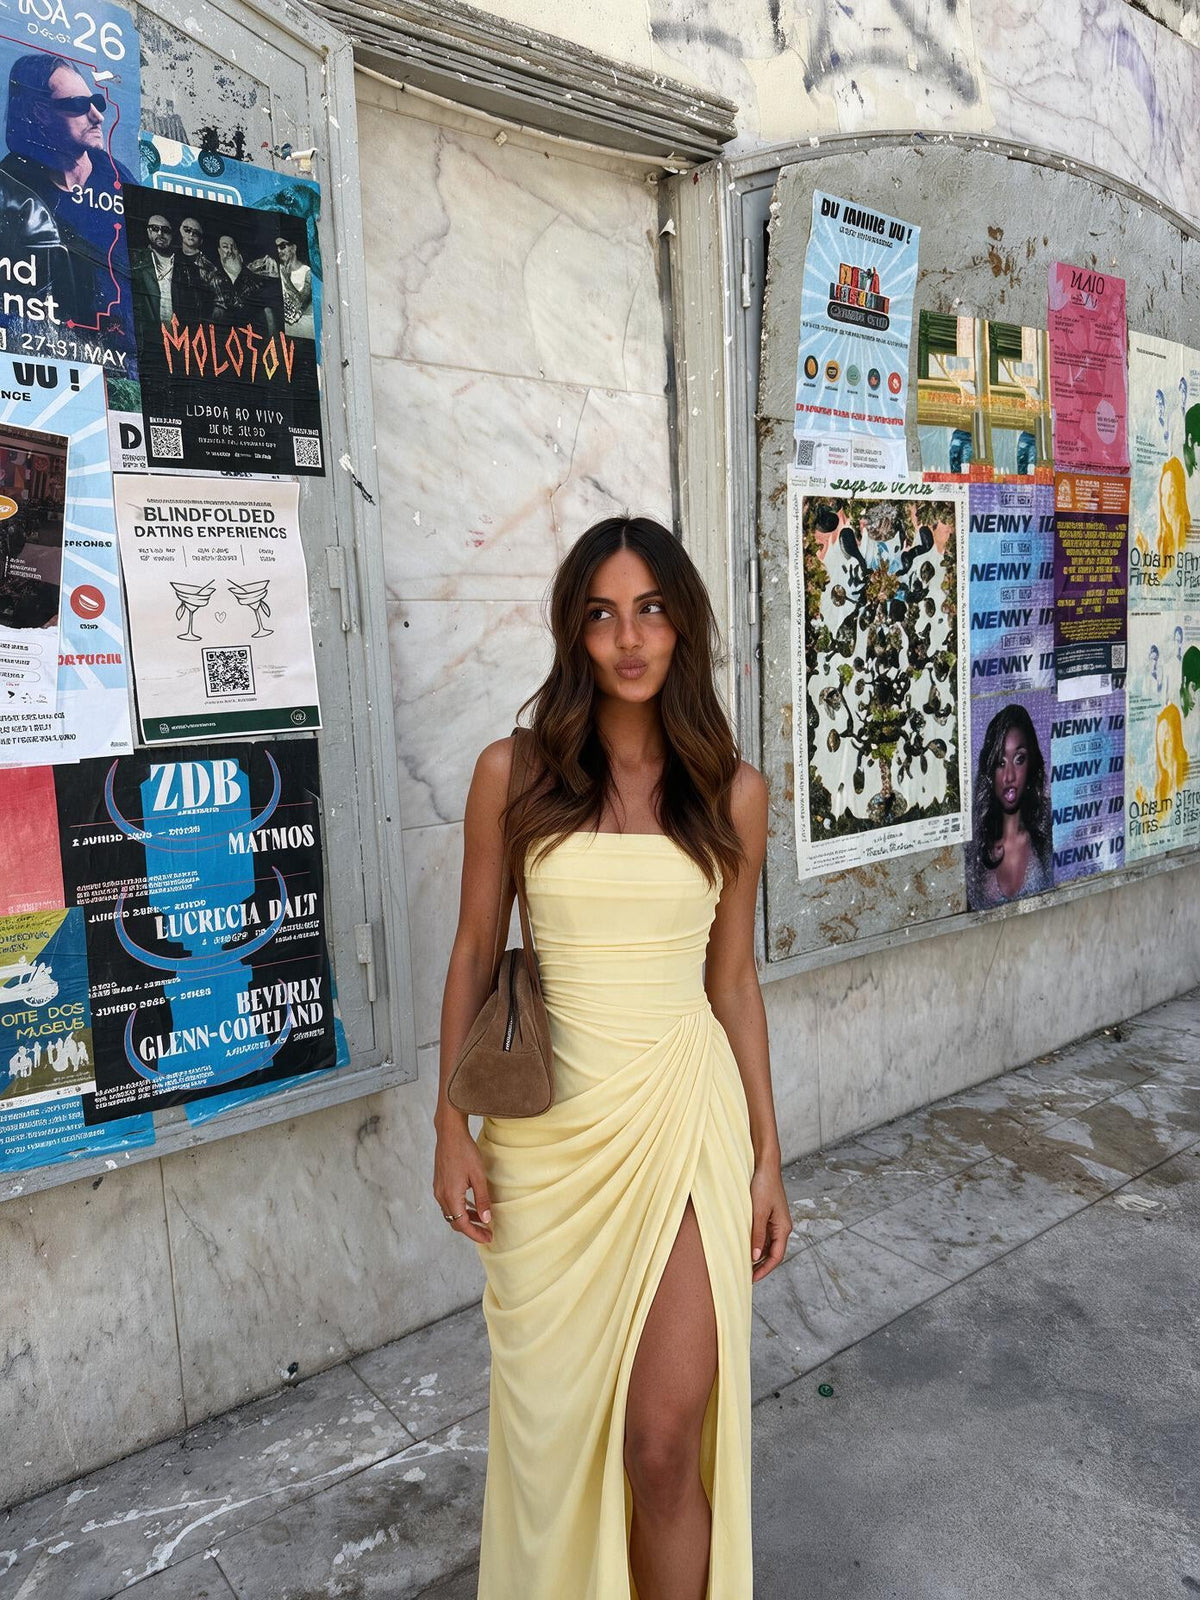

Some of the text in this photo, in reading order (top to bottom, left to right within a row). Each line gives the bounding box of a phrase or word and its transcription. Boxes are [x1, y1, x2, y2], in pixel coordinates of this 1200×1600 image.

[73, 12, 126, 60] 26
[72, 184, 125, 215] 31.05
[69, 368, 80, 391] !
[1, 390, 31, 401] NCE
[143, 506, 275, 523] BLINDFOLDED
[969, 514, 1033, 533] NENNY
[970, 563, 1032, 582] NENNY
[971, 608, 1033, 630] NENNY
[972, 654, 1033, 678] NENNY
[1051, 717, 1102, 739] NENNY
[1051, 756, 1124, 783] NENNY ID
[150, 760, 241, 812] ZDB
[1052, 799, 1103, 826] NENNY
[1108, 796, 1124, 814] ID
[228, 824, 315, 856] MATMOS
[1053, 836, 1124, 869] NENNY ID
[269, 893, 317, 921] DALT
[237, 977, 322, 1015] BEVERLY
[1, 1002, 85, 1028] OITE DOS
